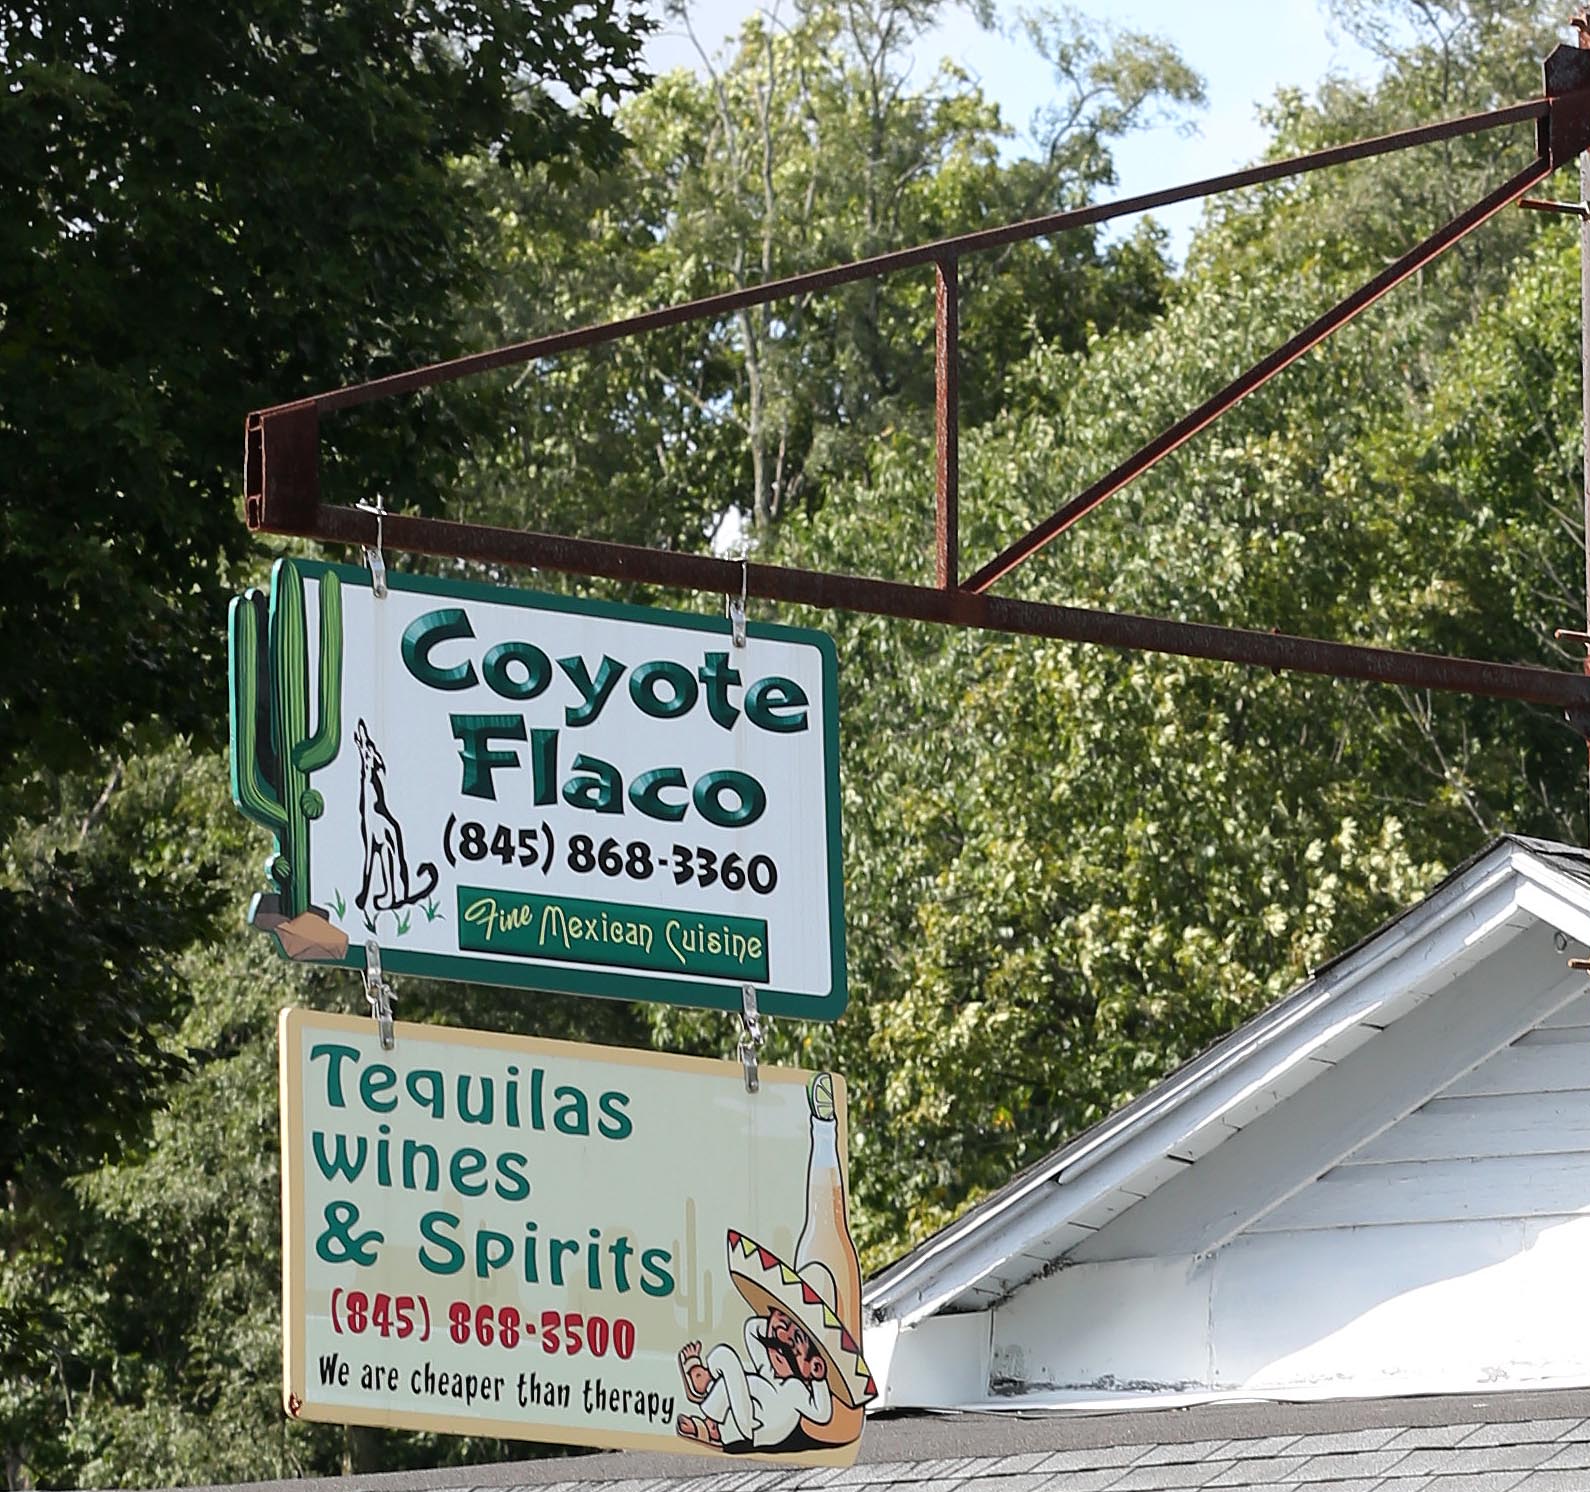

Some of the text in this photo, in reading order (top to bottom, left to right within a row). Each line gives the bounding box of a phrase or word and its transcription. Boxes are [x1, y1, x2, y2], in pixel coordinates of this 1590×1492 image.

[400, 607, 809, 732] Coyote
[449, 713, 766, 828] Flaco
[443, 814, 778, 895] (845) 868-3360
[464, 898, 762, 964] Fine Mexican Cuisine
[310, 1043, 634, 1141] Tequilas
[311, 1124, 531, 1202] wines
[316, 1200, 676, 1298] & Spirits
[331, 1287, 430, 1342] (845)
[318, 1353, 676, 1425] We are cheaper than therapy
